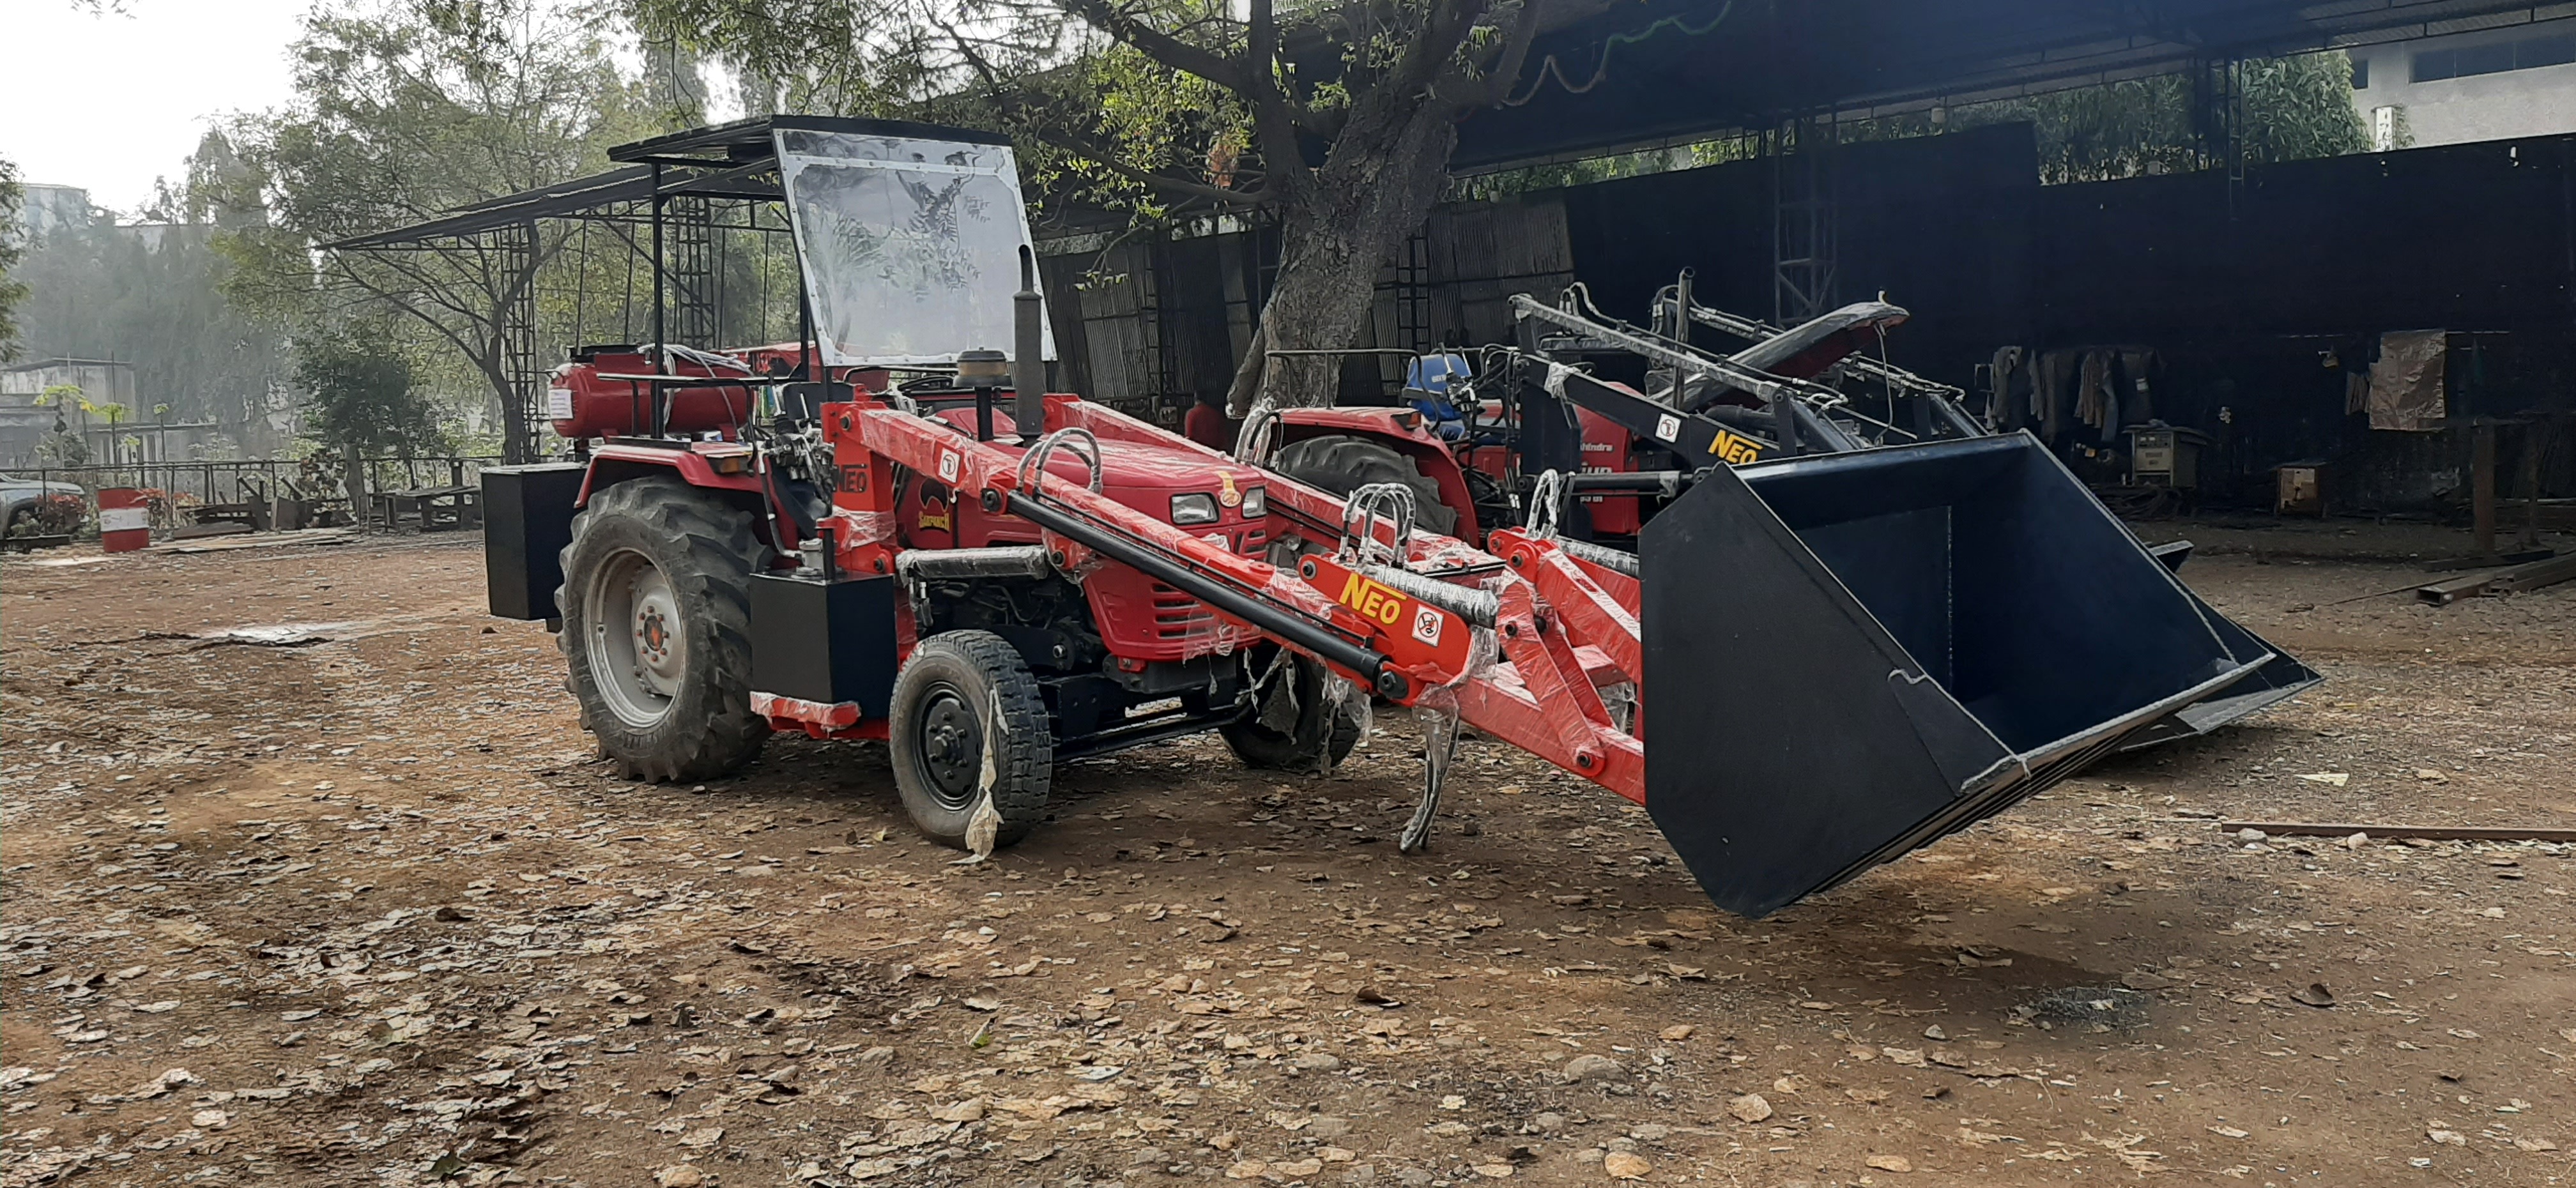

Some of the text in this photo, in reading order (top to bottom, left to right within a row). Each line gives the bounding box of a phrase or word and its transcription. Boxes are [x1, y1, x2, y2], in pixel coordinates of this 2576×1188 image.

[1708, 429, 1763, 464] NEO
[832, 464, 868, 492] NEO
[1339, 572, 1407, 625] NEO
